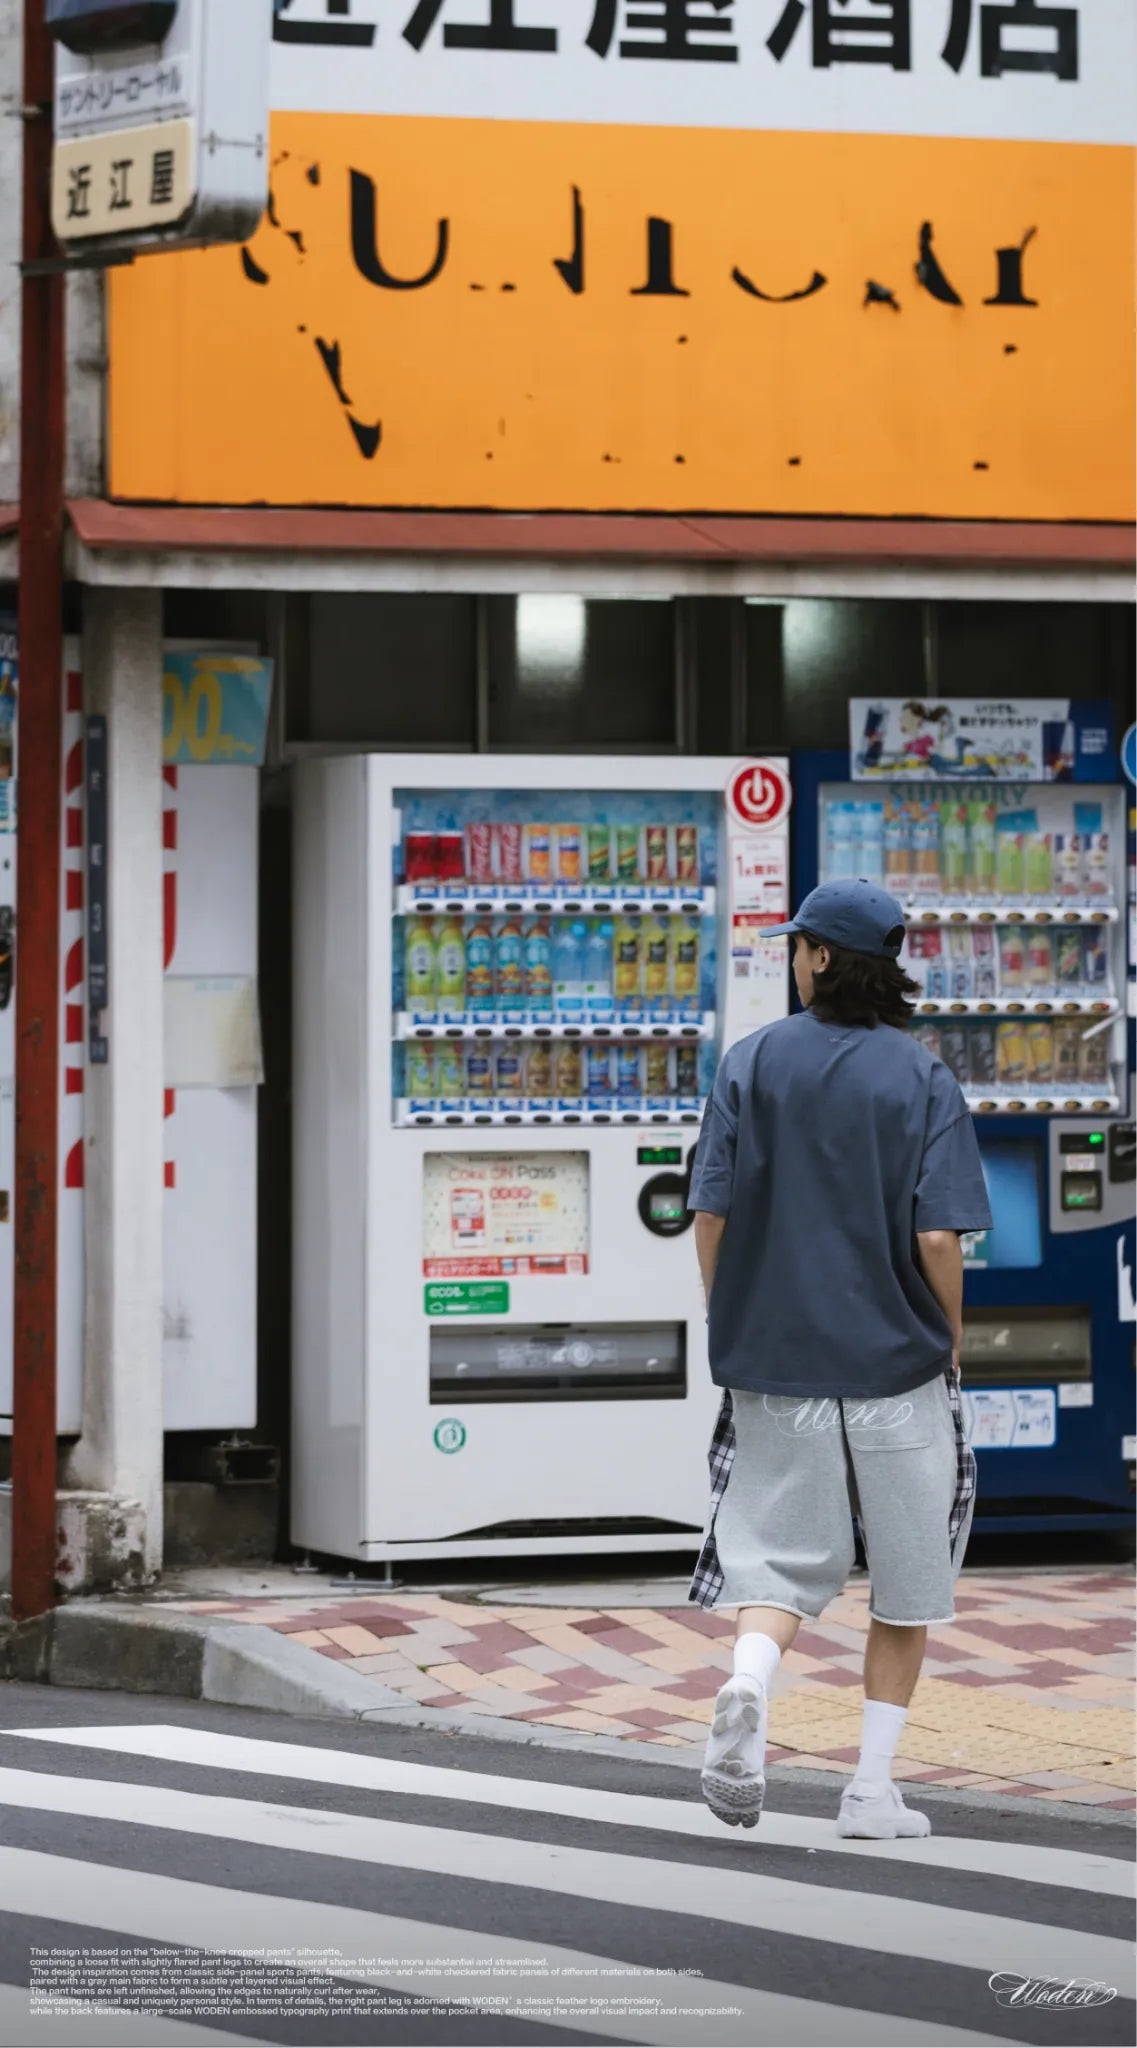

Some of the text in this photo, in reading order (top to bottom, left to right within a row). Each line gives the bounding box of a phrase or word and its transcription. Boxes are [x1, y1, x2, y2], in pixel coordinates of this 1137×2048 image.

[59, 66, 183, 116] サントリーローヤル
[66, 149, 175, 220] 近江屋
[517, 1164, 557, 1179] Pass
